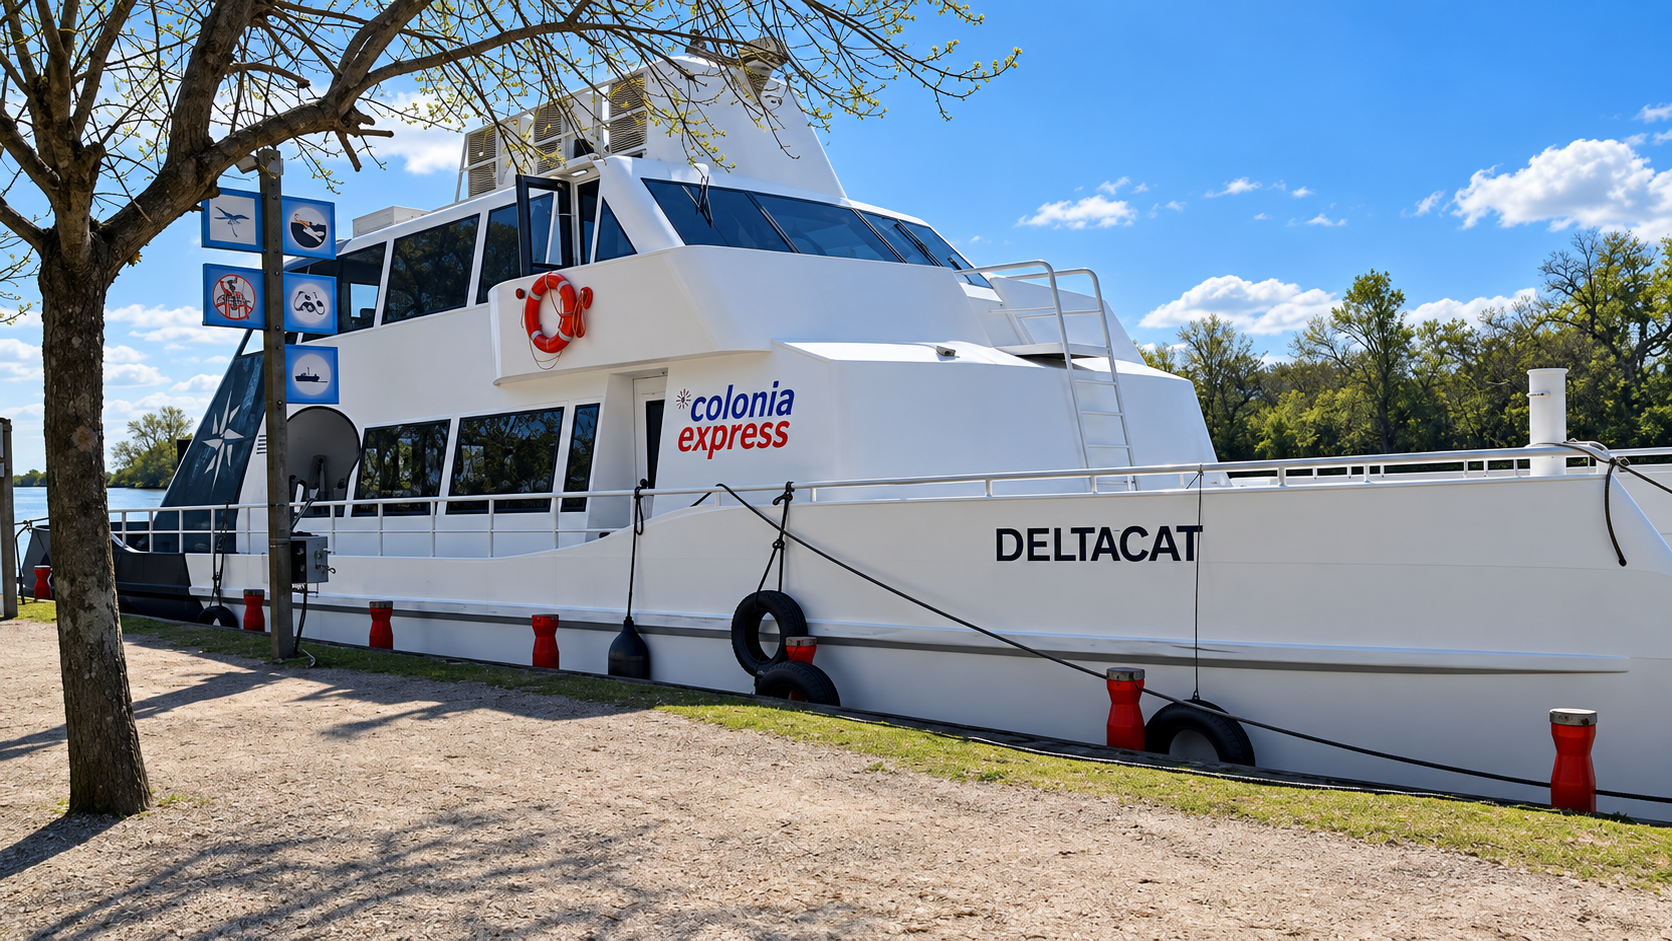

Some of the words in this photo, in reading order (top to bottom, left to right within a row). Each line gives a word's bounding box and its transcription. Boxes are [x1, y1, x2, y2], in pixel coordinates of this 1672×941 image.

[690, 380, 795, 422] colonia
[677, 420, 790, 460] express
[996, 525, 1203, 562] DELTACAT
